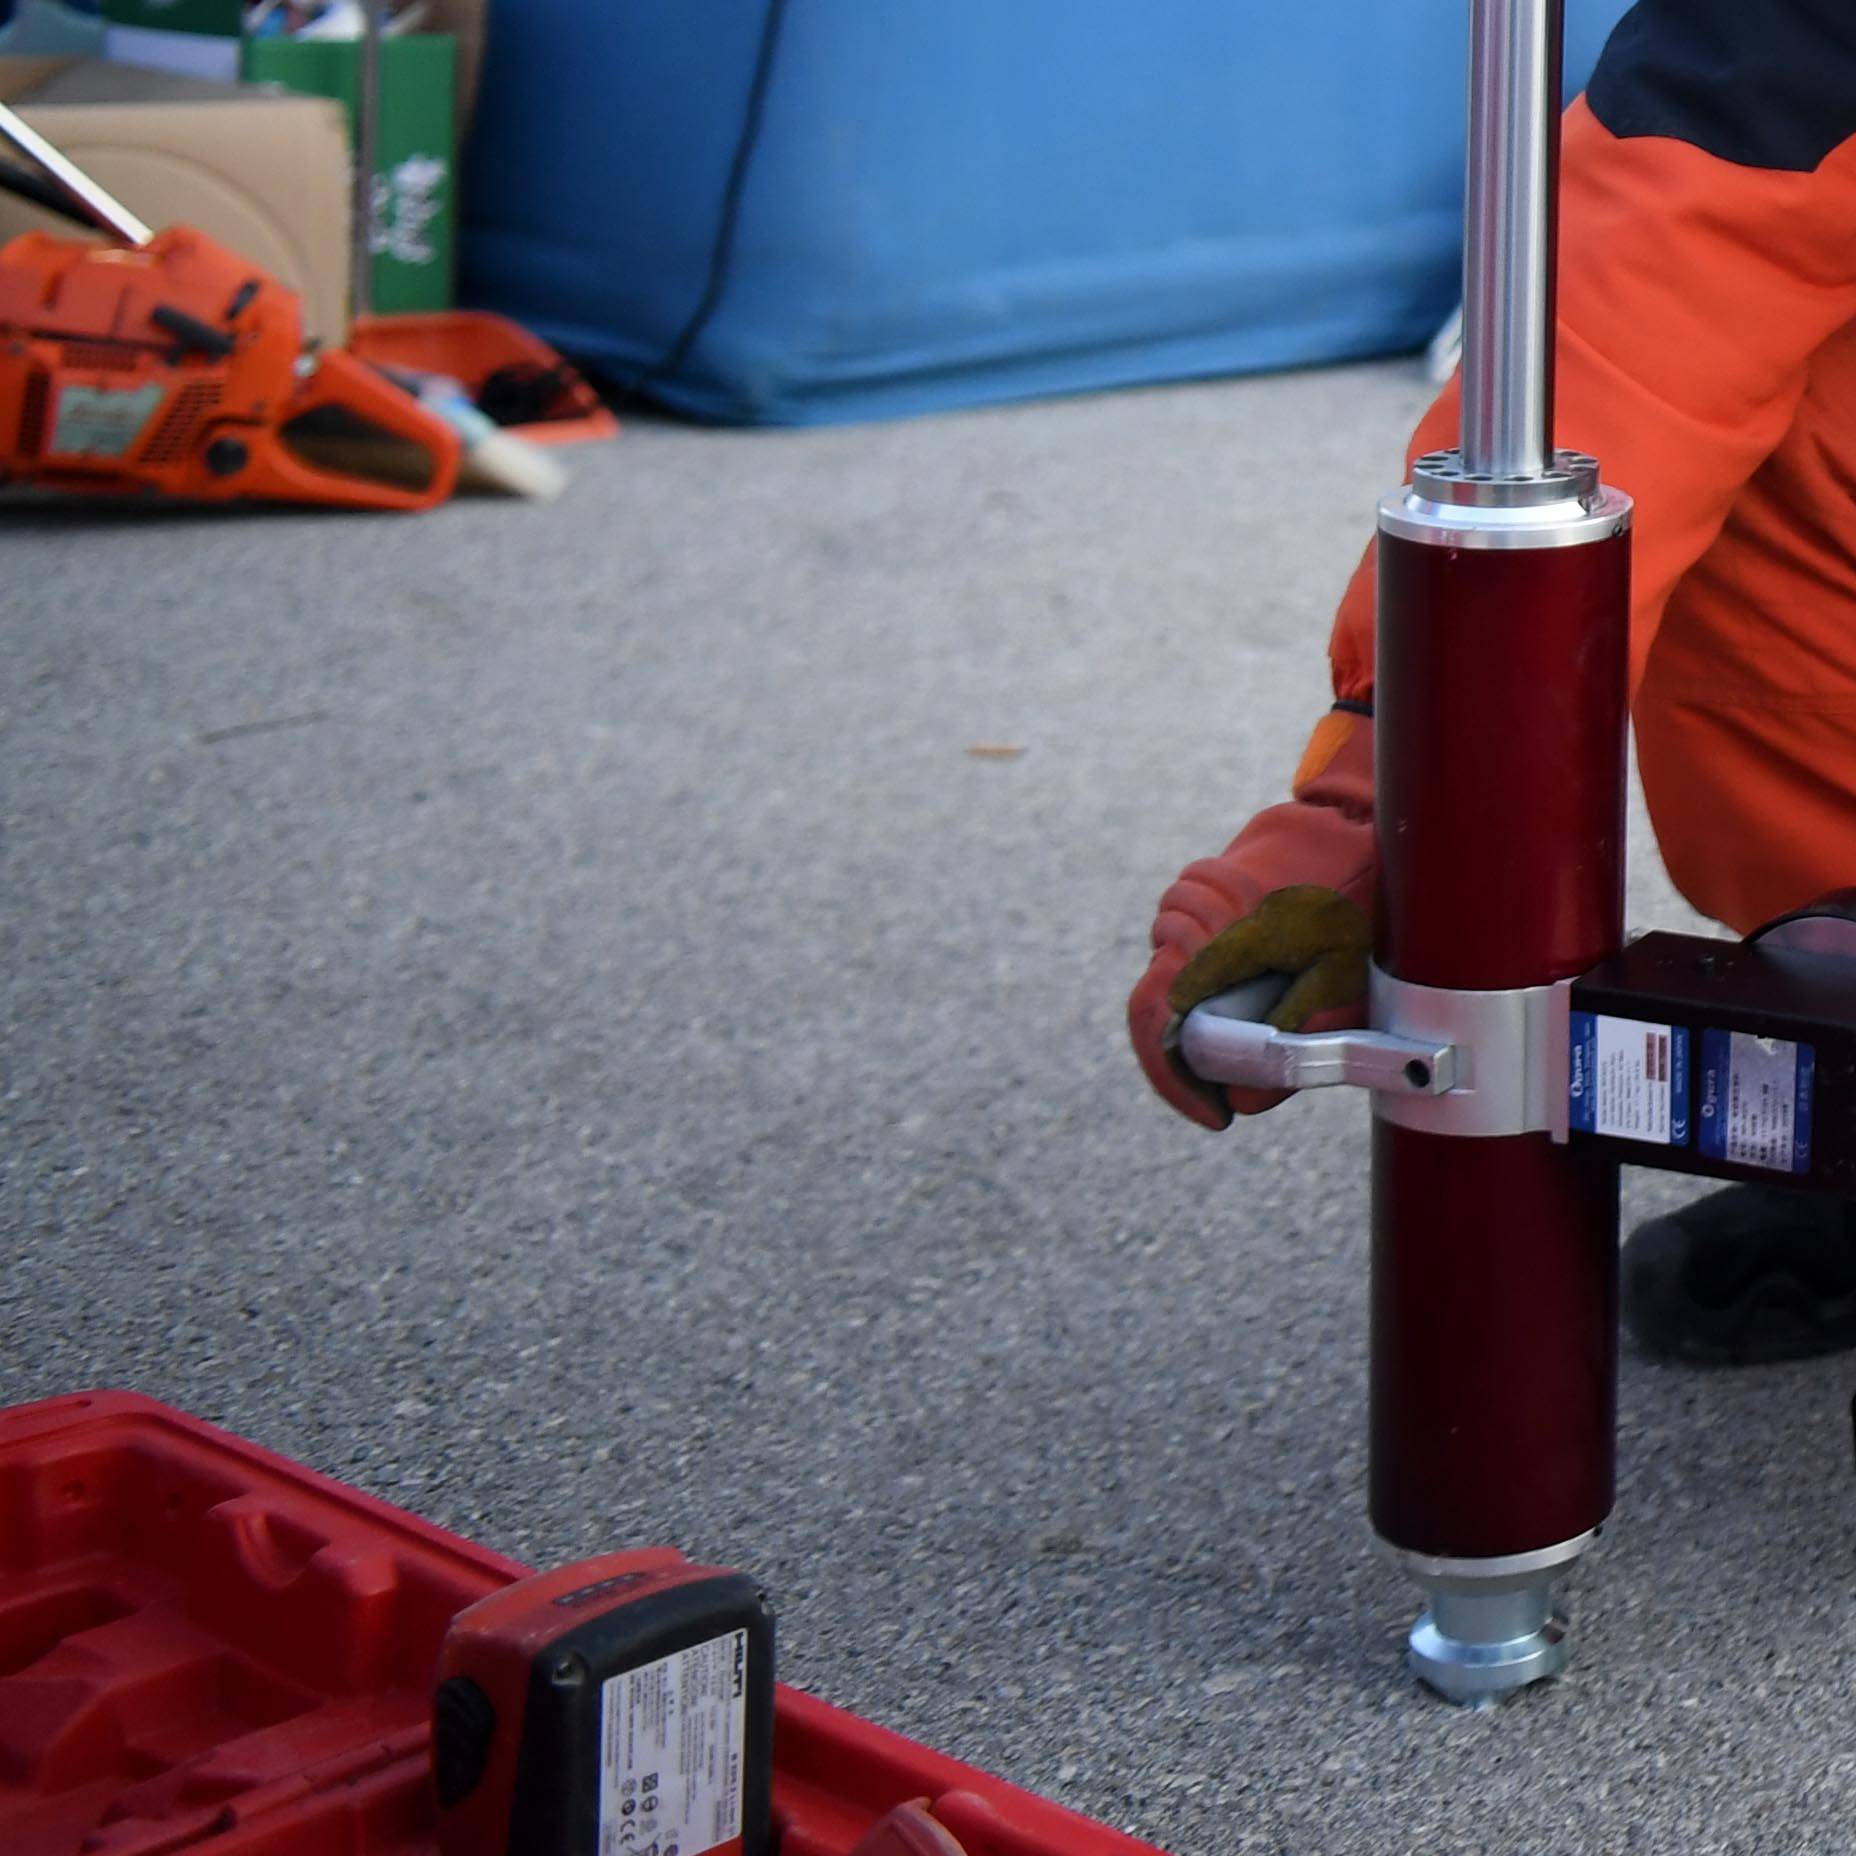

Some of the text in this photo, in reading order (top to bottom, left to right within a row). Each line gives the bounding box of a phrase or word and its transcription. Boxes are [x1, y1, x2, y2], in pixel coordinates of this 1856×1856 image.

[1570, 1044, 1584, 1098] Ogura
[1701, 1068, 1716, 1118] Ogura
[731, 1630, 744, 1699] HILTI
